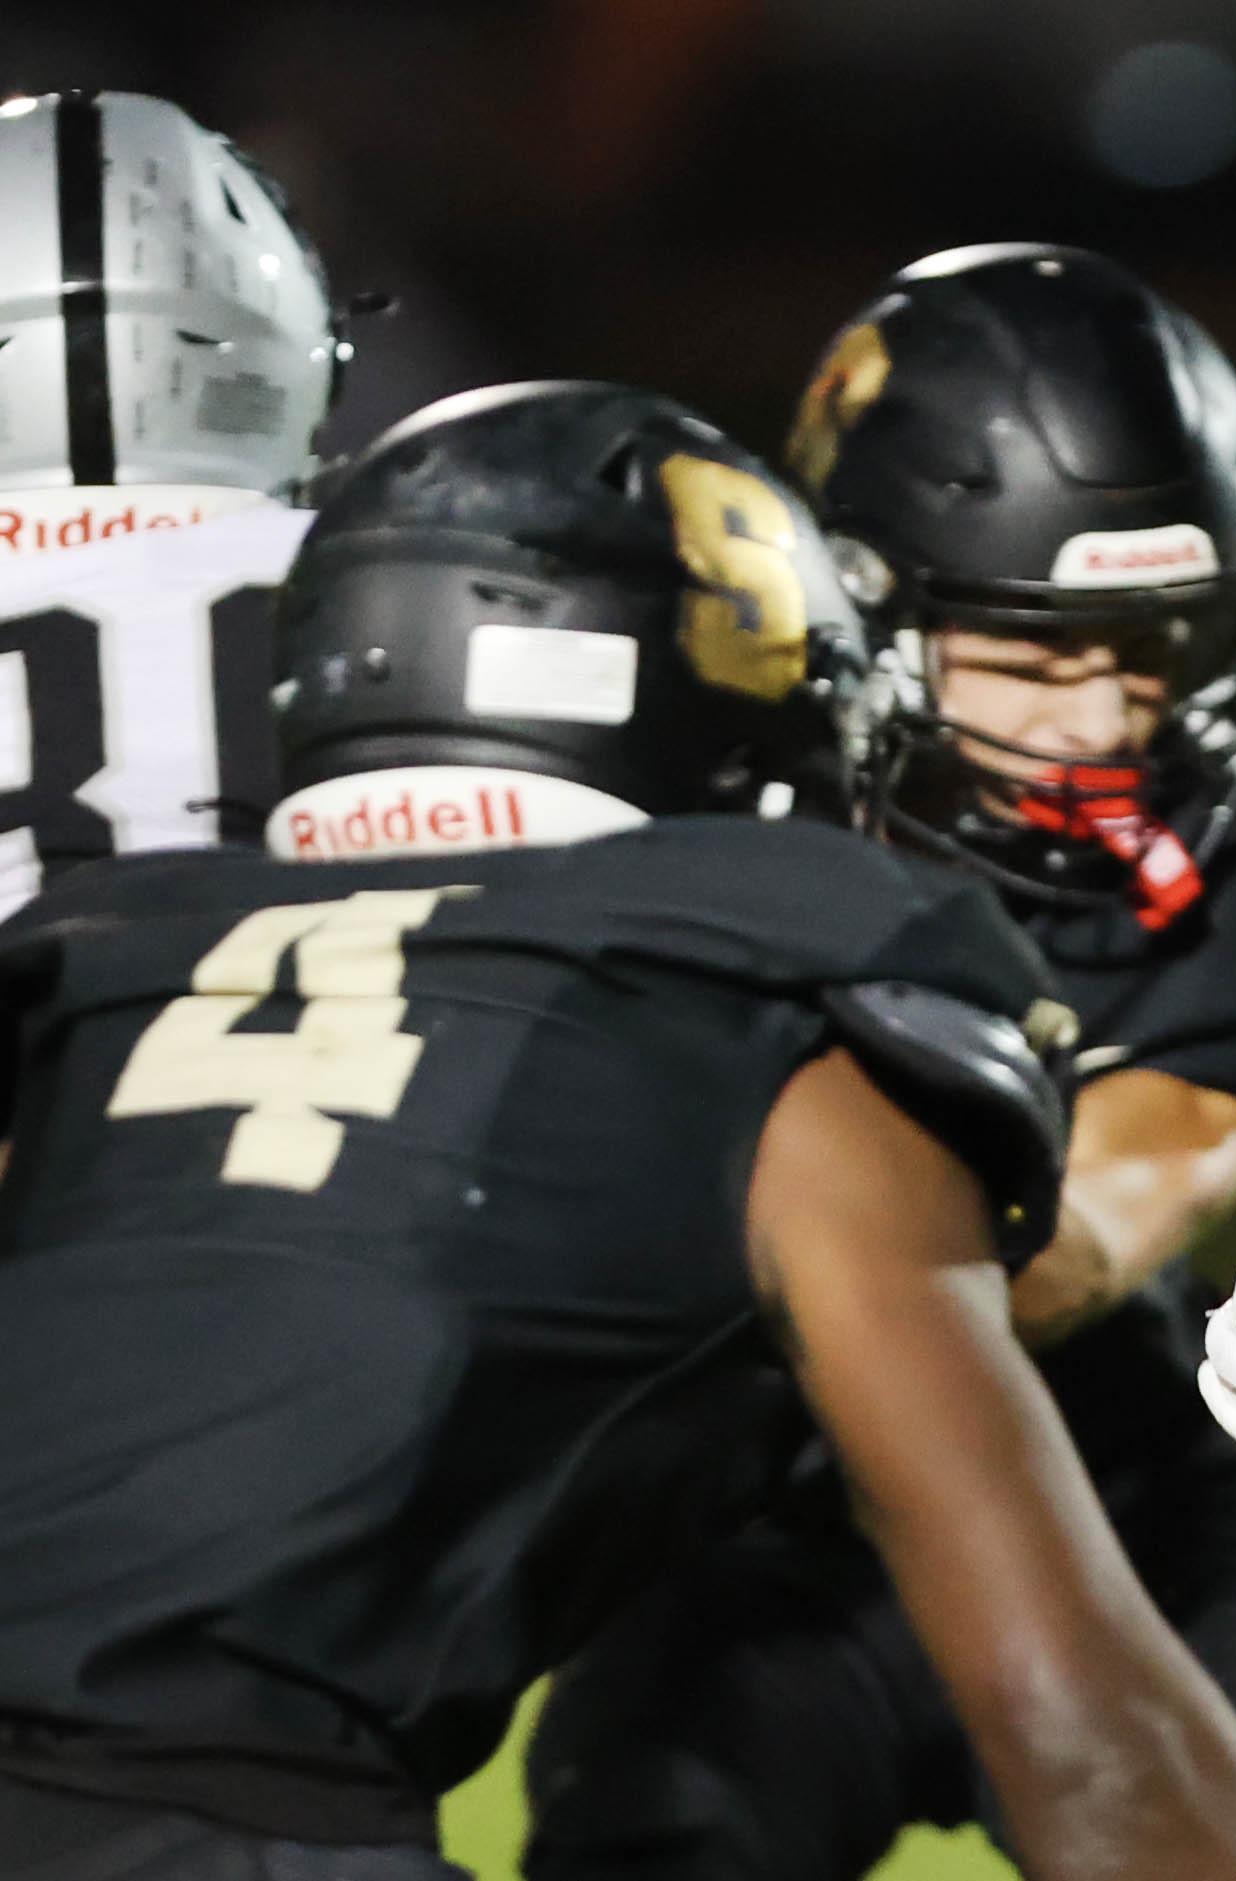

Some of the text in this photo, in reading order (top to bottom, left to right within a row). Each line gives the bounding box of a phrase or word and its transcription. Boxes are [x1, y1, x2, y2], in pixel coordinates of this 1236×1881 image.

[0, 506, 204, 552] Ridd
[290, 787, 529, 862] Riddell
[106, 884, 484, 1192] 4
